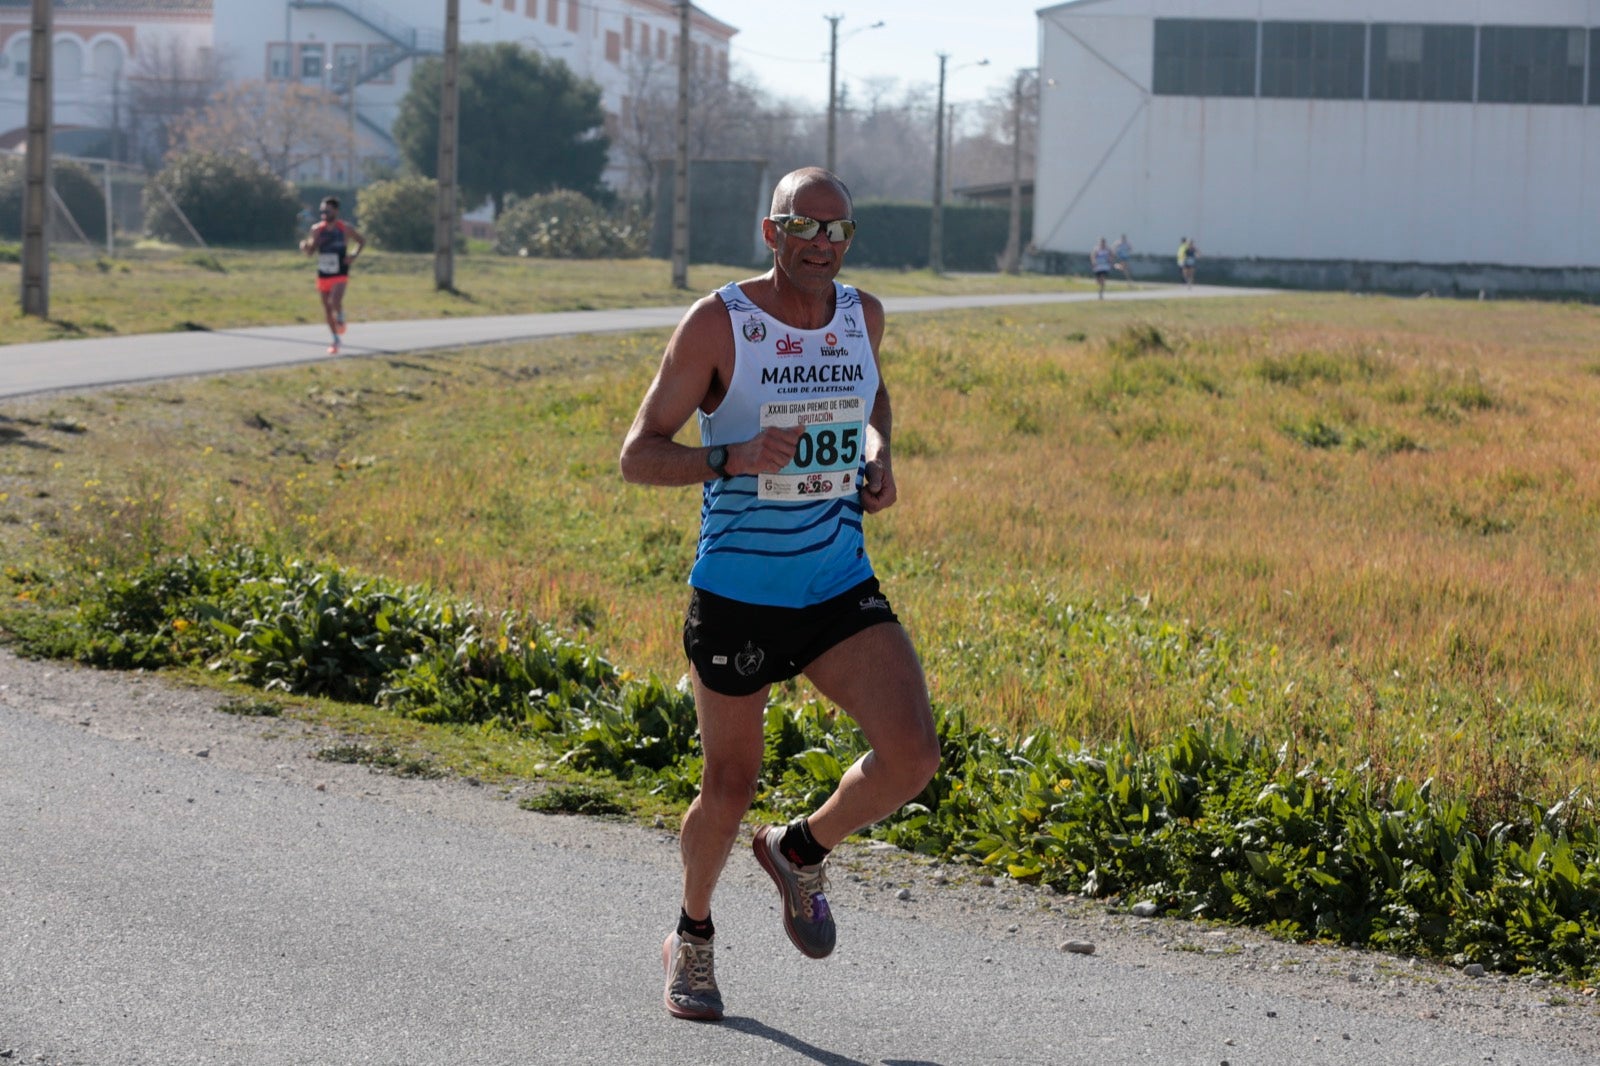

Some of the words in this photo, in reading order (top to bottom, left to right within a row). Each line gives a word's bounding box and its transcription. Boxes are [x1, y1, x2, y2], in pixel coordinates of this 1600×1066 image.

[761, 364, 864, 385] MARACENA
[812, 385, 855, 393] ATLETISMO
[789, 403, 806, 414] GRAN
[807, 401, 829, 412] PREMIO
[830, 400, 838, 410] DE
[839, 398, 859, 409] FONDO
